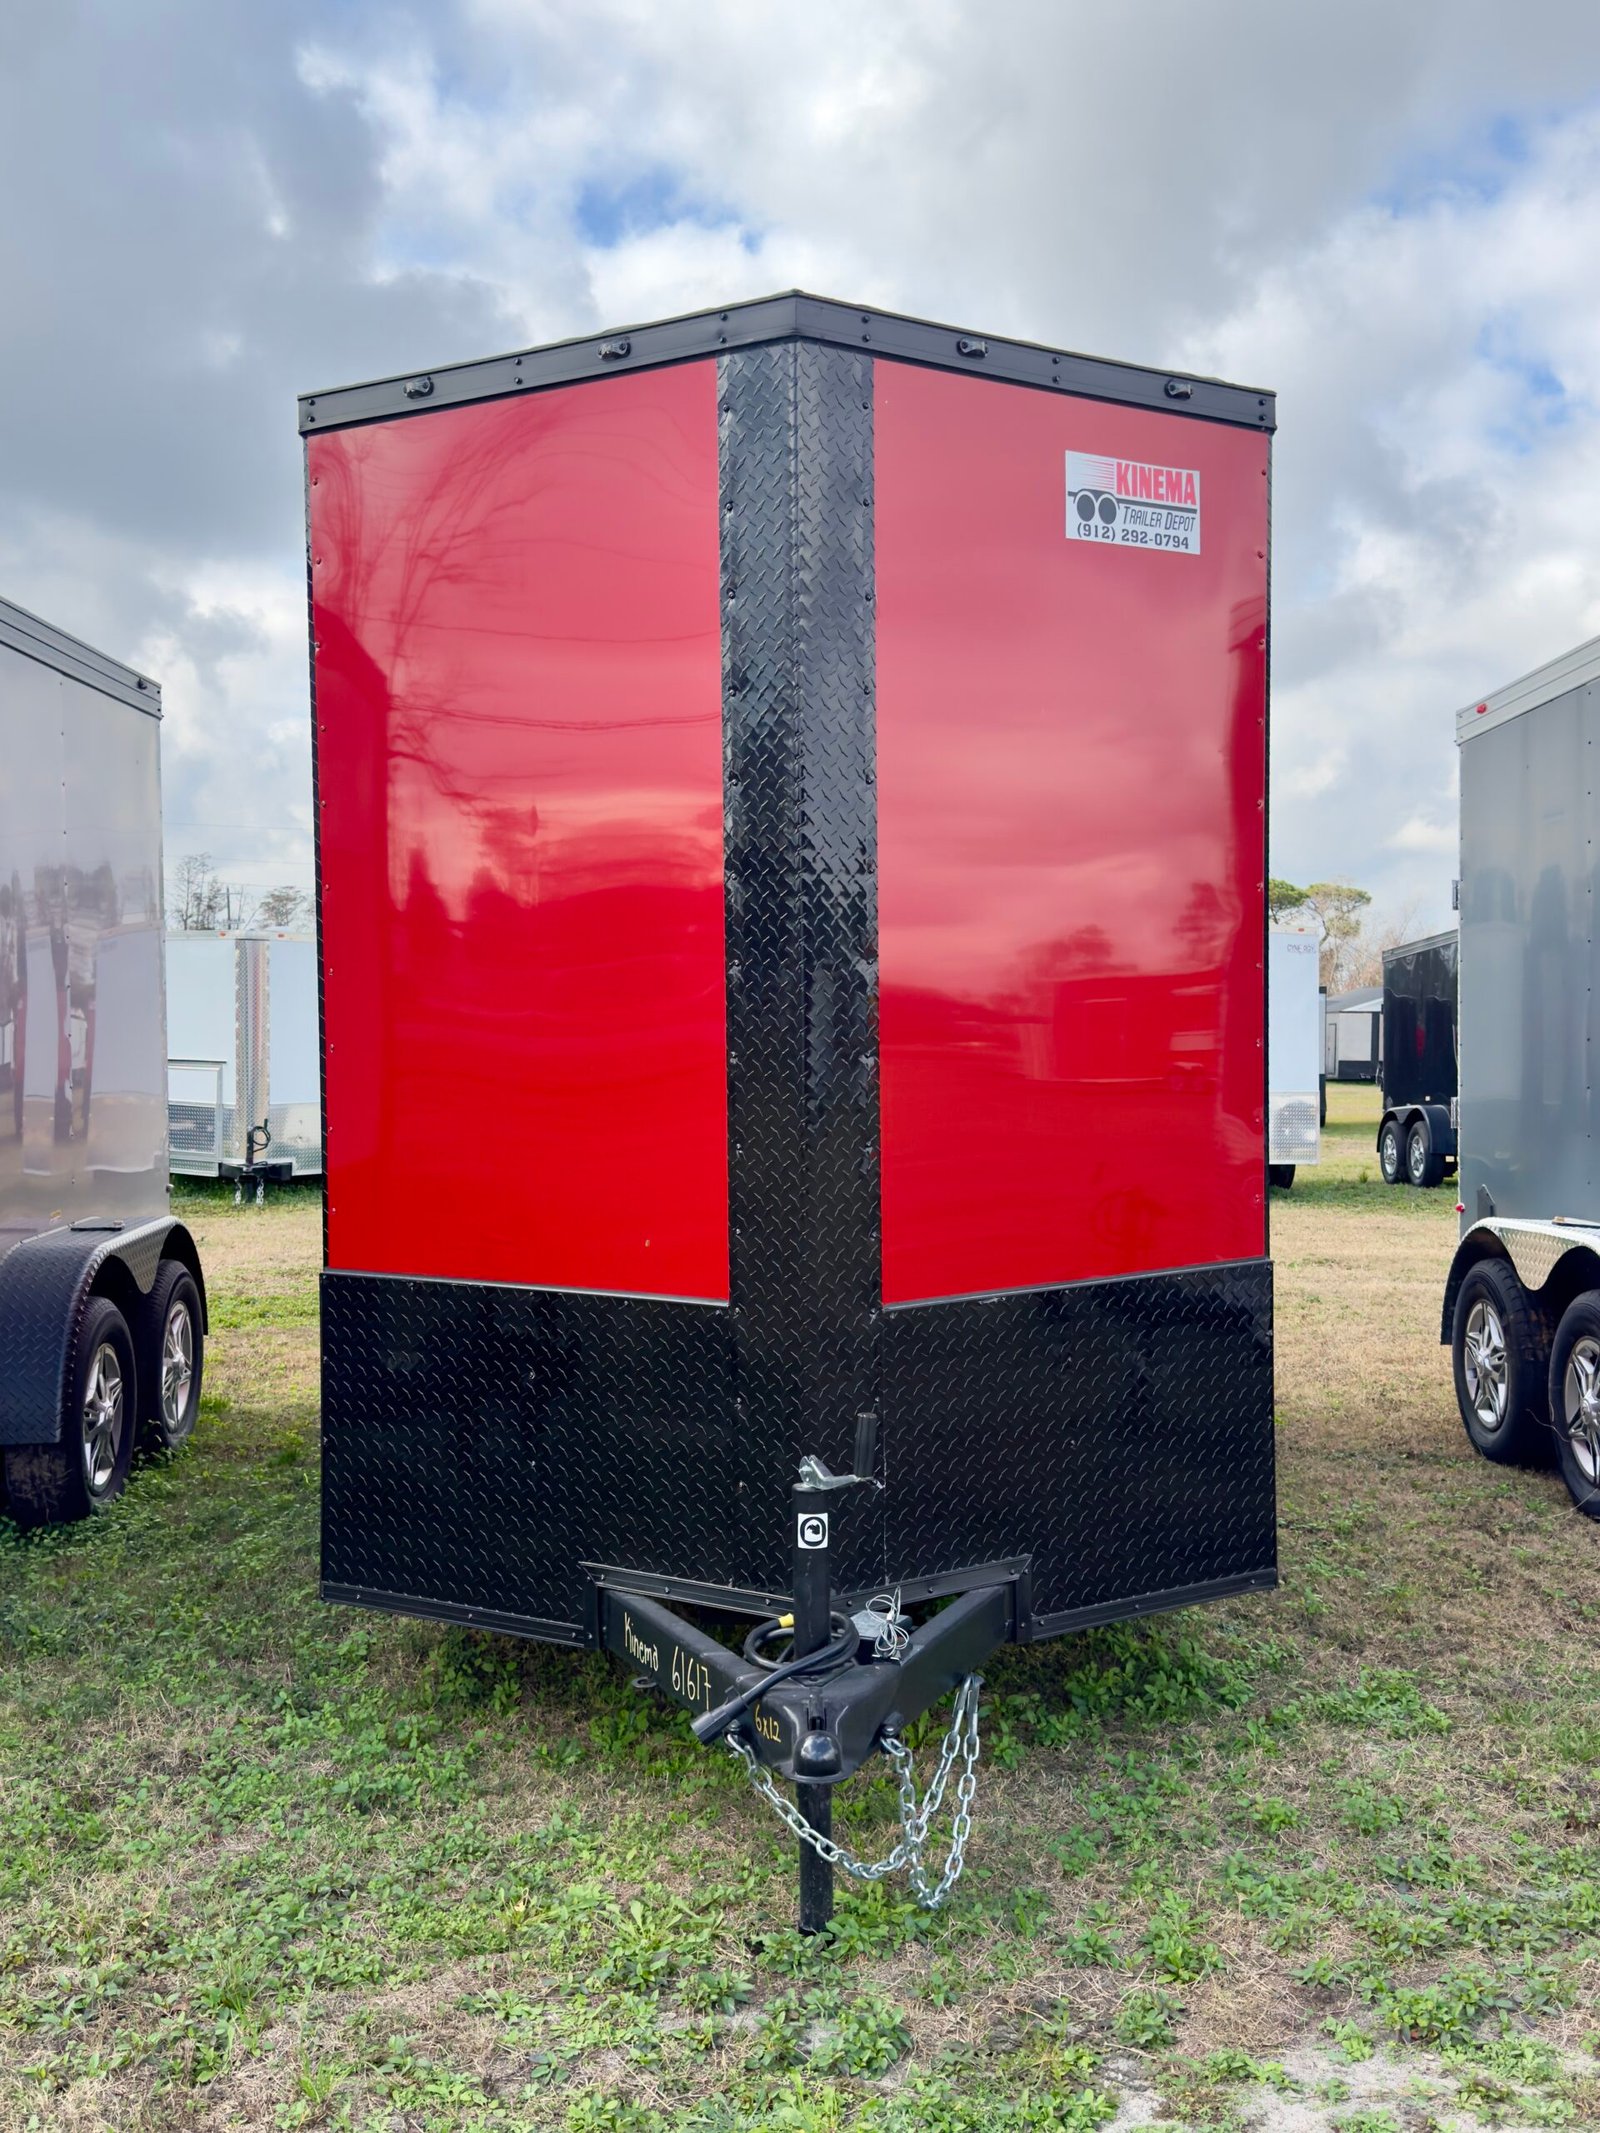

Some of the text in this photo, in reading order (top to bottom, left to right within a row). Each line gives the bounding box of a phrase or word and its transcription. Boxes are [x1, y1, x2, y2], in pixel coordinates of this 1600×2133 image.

[1116, 461, 1197, 506] KINEMA
[1077, 522, 1189, 550] (912) 292-0794
[1123, 507, 1196, 532] TRAILER DEPOT
[624, 1612, 659, 1672] Kinema
